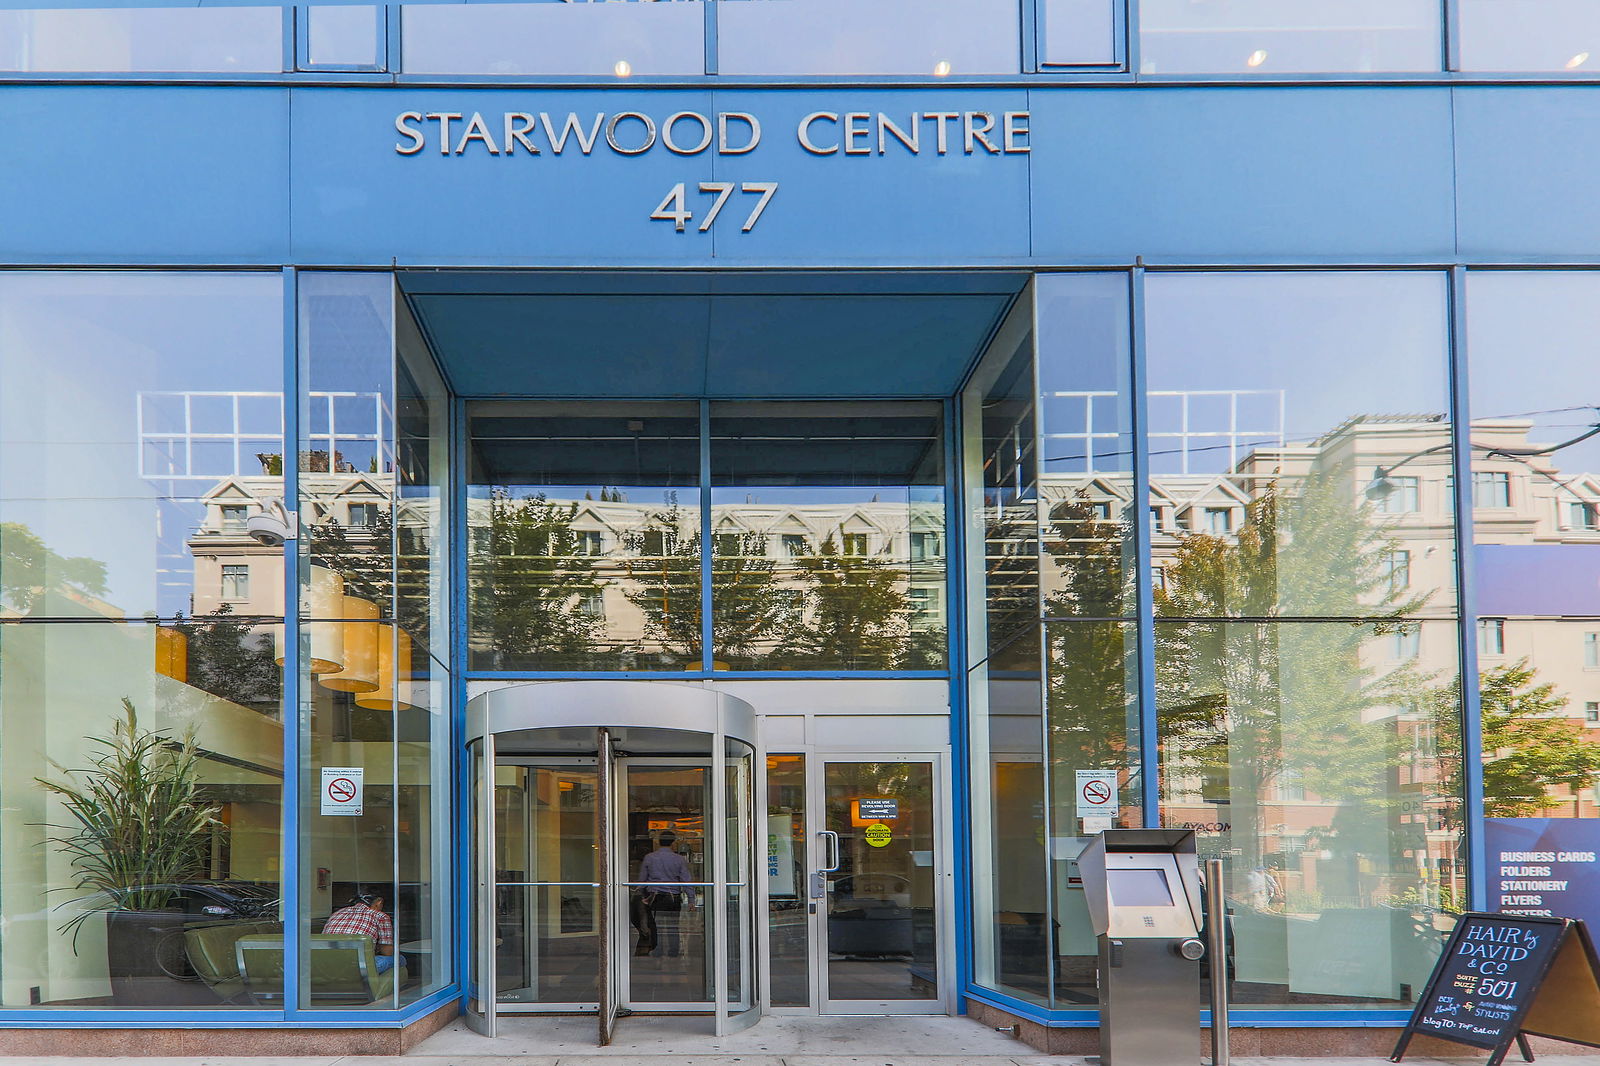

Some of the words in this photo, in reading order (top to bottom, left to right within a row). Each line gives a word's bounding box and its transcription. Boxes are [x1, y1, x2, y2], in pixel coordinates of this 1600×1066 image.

[394, 111, 762, 156] STARWOOD
[797, 111, 1032, 156] CENTRE
[650, 181, 779, 234] 477
[1500, 852, 1556, 862] BUSINESS
[1557, 852, 1596, 862] CARDS
[1500, 866, 1552, 877] FOLDERS
[1500, 880, 1568, 891] STATIONERY
[1501, 895, 1542, 906] FLYERS
[1466, 926, 1521, 944] HAIR
[1524, 929, 1540, 950] by
[1458, 942, 1528, 962] DAVID
[1467, 958, 1478, 968] &
[1456, 973, 1479, 983] SUITE
[1453, 981, 1476, 990] BUZZ
[1477, 978, 1518, 1000] 501
[1474, 1008, 1510, 1021] STYLISTS
